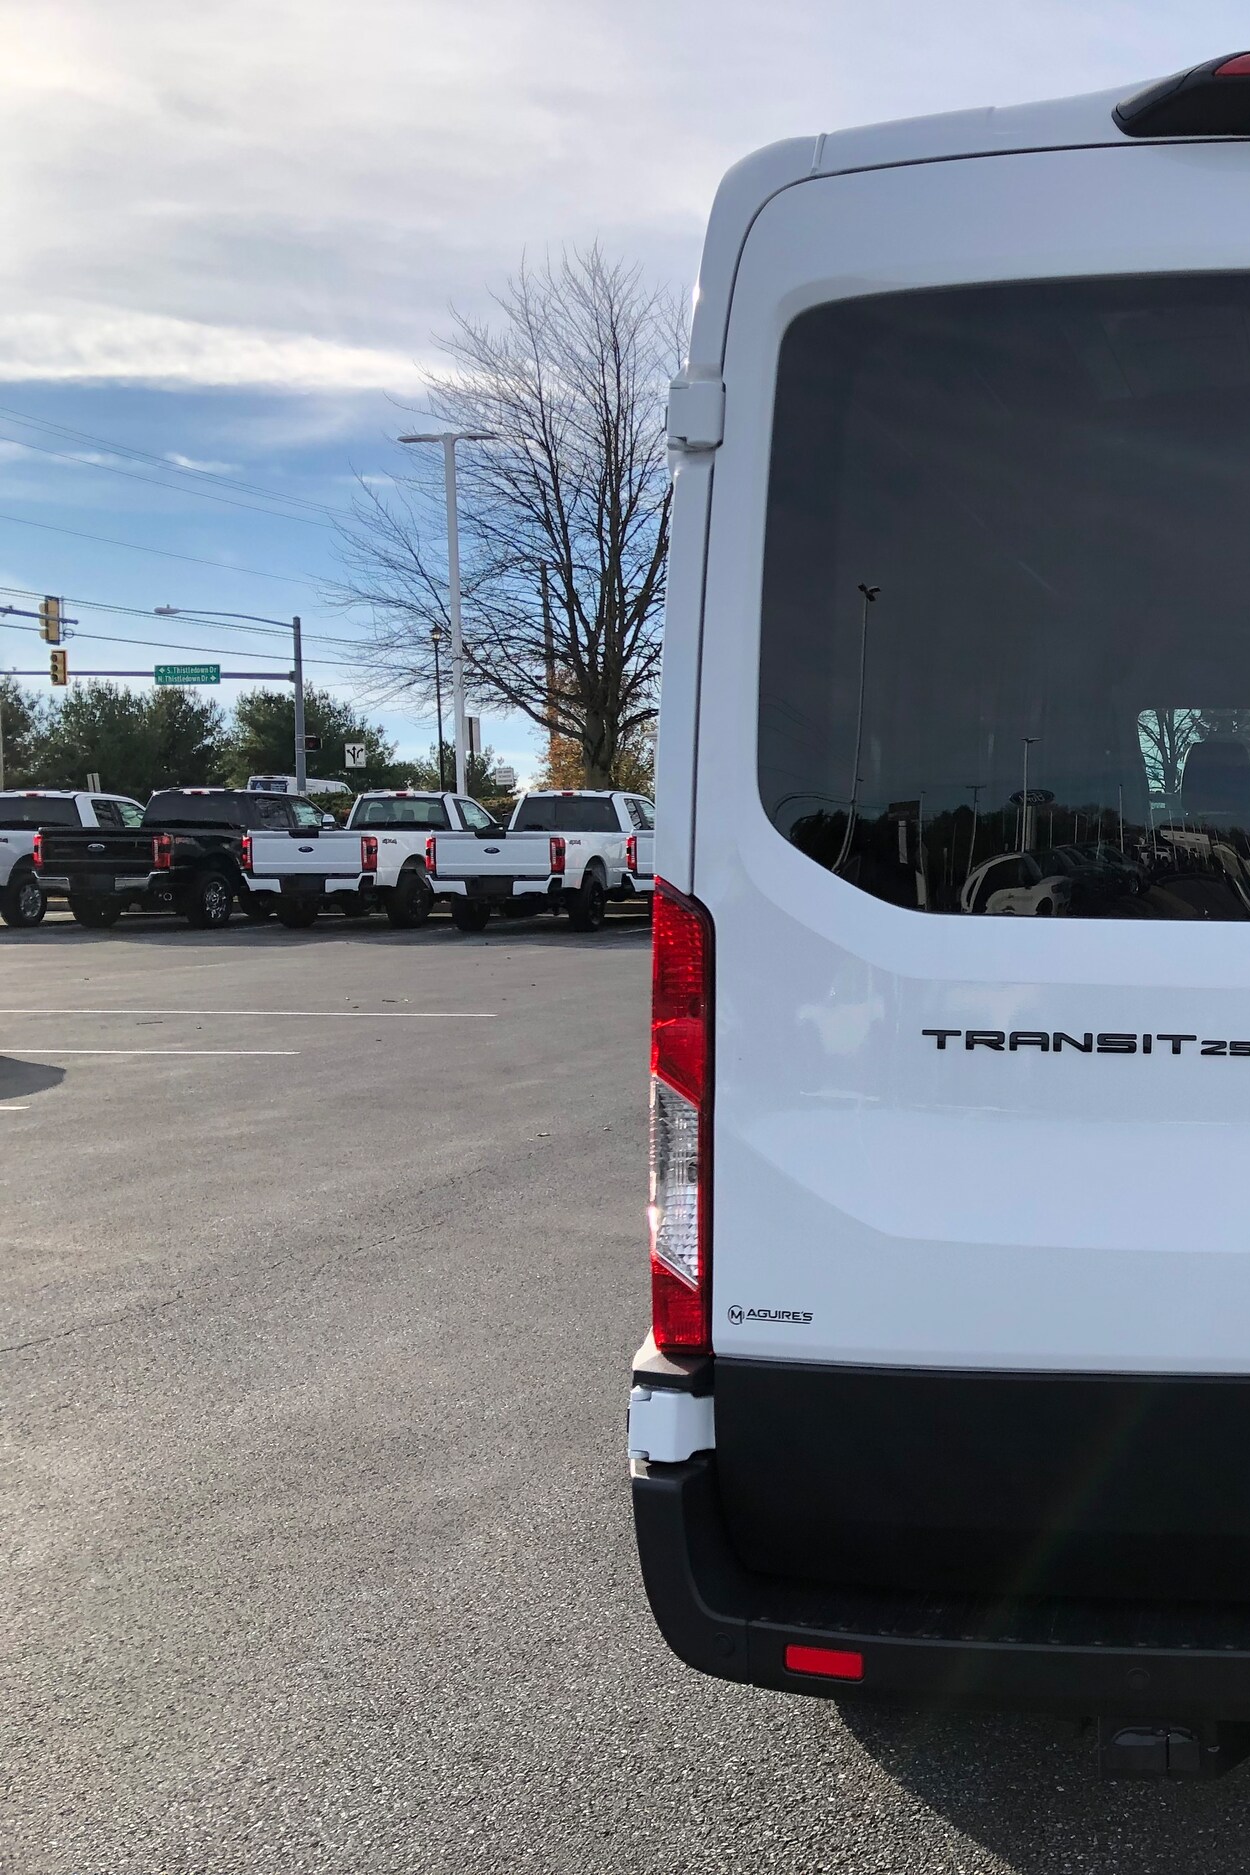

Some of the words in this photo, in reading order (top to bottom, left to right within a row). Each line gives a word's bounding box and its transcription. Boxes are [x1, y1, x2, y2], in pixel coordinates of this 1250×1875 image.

[173, 666, 208, 674] Thistledown
[165, 675, 200, 683] Thistledown
[921, 1029, 1197, 1055] TRANSIT
